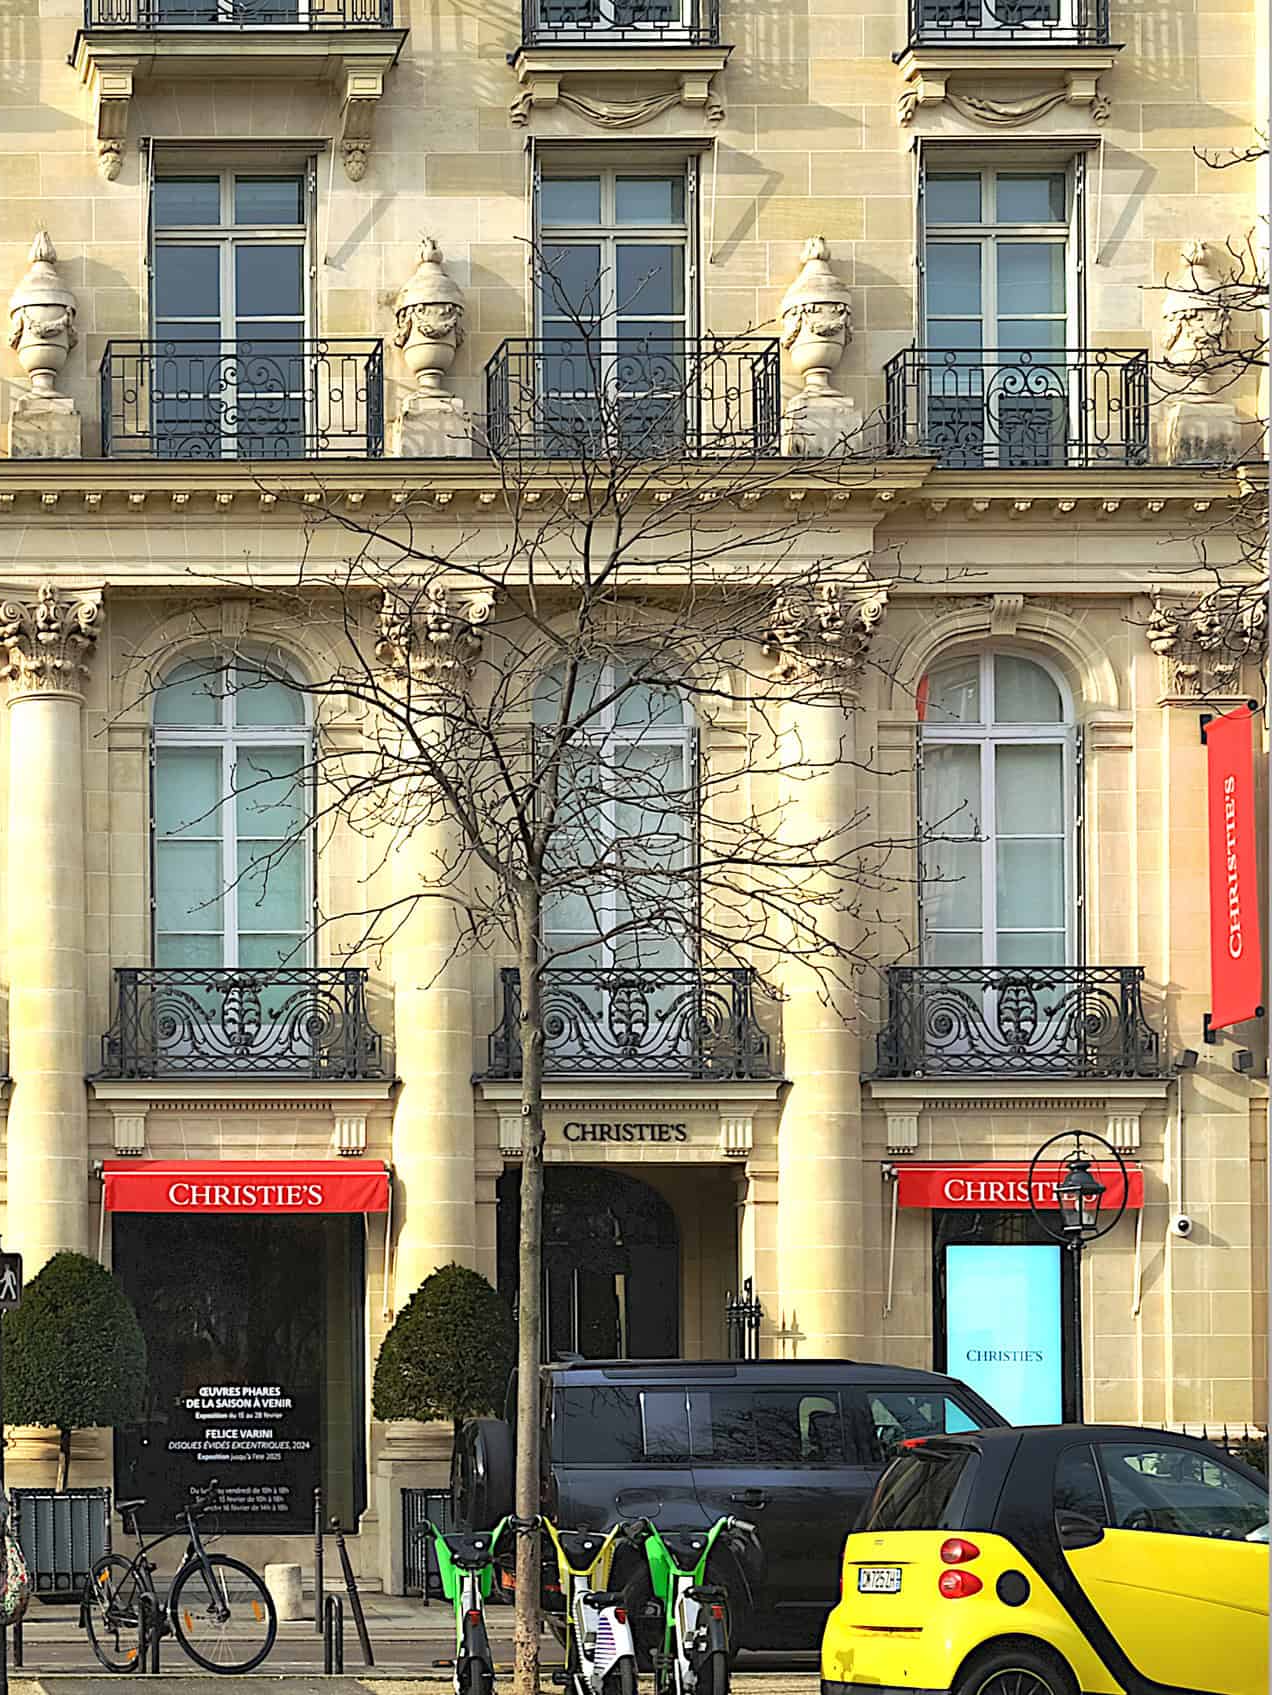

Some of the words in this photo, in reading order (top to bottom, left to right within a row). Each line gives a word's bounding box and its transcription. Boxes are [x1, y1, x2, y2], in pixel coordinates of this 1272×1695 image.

[1224, 776, 1242, 959] CHRISTIE'S
[563, 1122, 687, 1142] CHRISTIE'S
[168, 1183, 323, 1206] CHRISTIE'S
[966, 1350, 1044, 1362] CHRISTIE'S
[199, 1386, 241, 1397] ŒUVRES
[242, 1386, 281, 1397] PHARES
[186, 1398, 200, 1409] DE
[201, 1398, 215, 1409] LA
[216, 1398, 252, 1409] SAISON
[253, 1397, 262, 1409] À
[262, 1398, 293, 1409] VENIR
[205, 1429, 239, 1439] FELICE
[239, 1429, 273, 1439] VARINI
[168, 1441, 202, 1450] DISQUES
[203, 1440, 231, 1450] ÉVIDÉS
[231, 1441, 291, 1451] EXCENTRIQUES,
[292, 1441, 311, 1450] 2024
